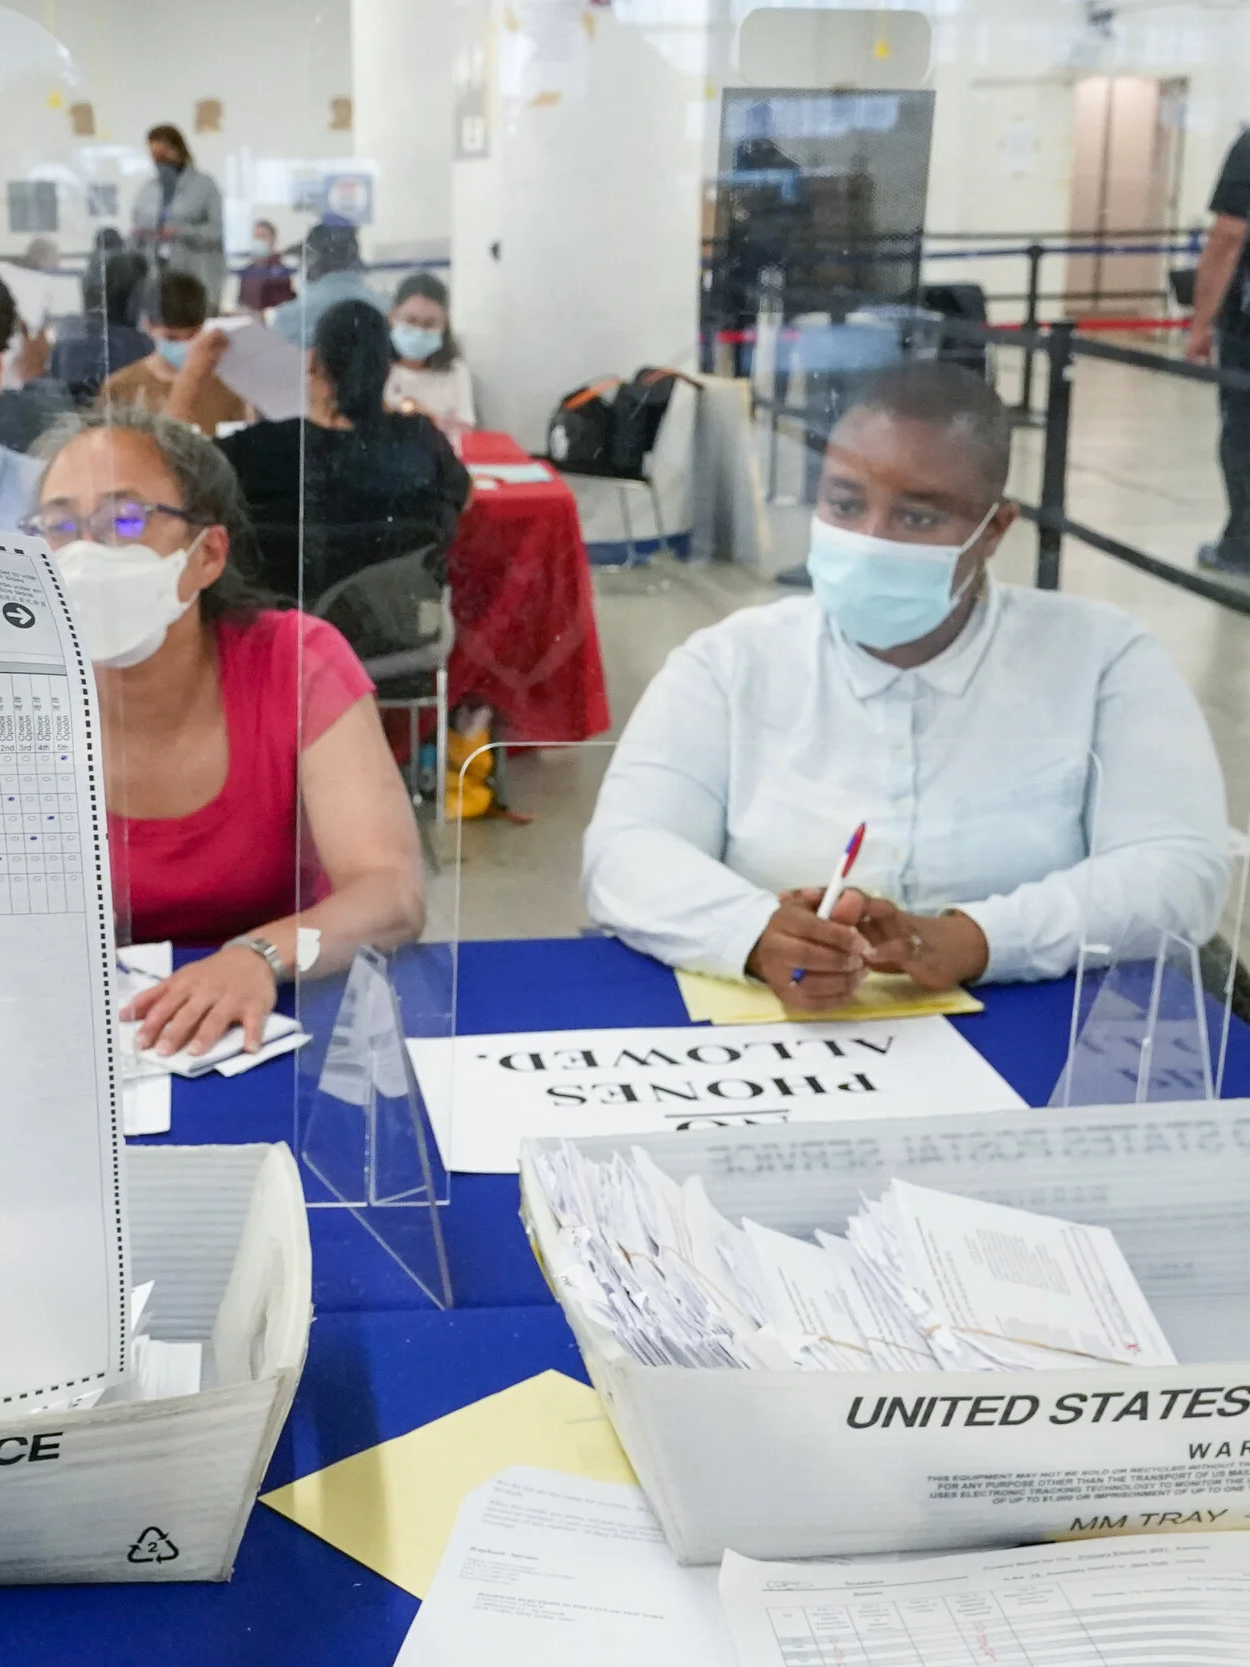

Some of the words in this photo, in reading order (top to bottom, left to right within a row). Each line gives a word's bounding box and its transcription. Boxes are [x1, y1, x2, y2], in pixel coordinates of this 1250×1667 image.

[476, 1036, 897, 1072] ALLOWED.
[546, 1072, 880, 1106] PHONES
[846, 1395, 1040, 1429] UNITED
[1049, 1386, 1250, 1425] STATES
[953, 1473, 1013, 1481] EQUIPMENT
[985, 1480, 1034, 1489] PURPOSE
[1038, 1478, 1074, 1487] OTHER
[1077, 1477, 1104, 1485] THAN
[1130, 1472, 1192, 1482] TRANSPORT
[960, 1489, 1026, 1499] ELECTRONIC
[1029, 1486, 1082, 1496] TRACKING
[1086, 1483, 1155, 1493] TECHNOLOGY
[1175, 1479, 1222, 1488] MONITOR
[992, 1497, 1008, 1505] OF
[1093, 1490, 1171, 1500] IMPRISONMENT
[1070, 1515, 1129, 1531] MM
[1140, 1508, 1229, 1527] TRAY
